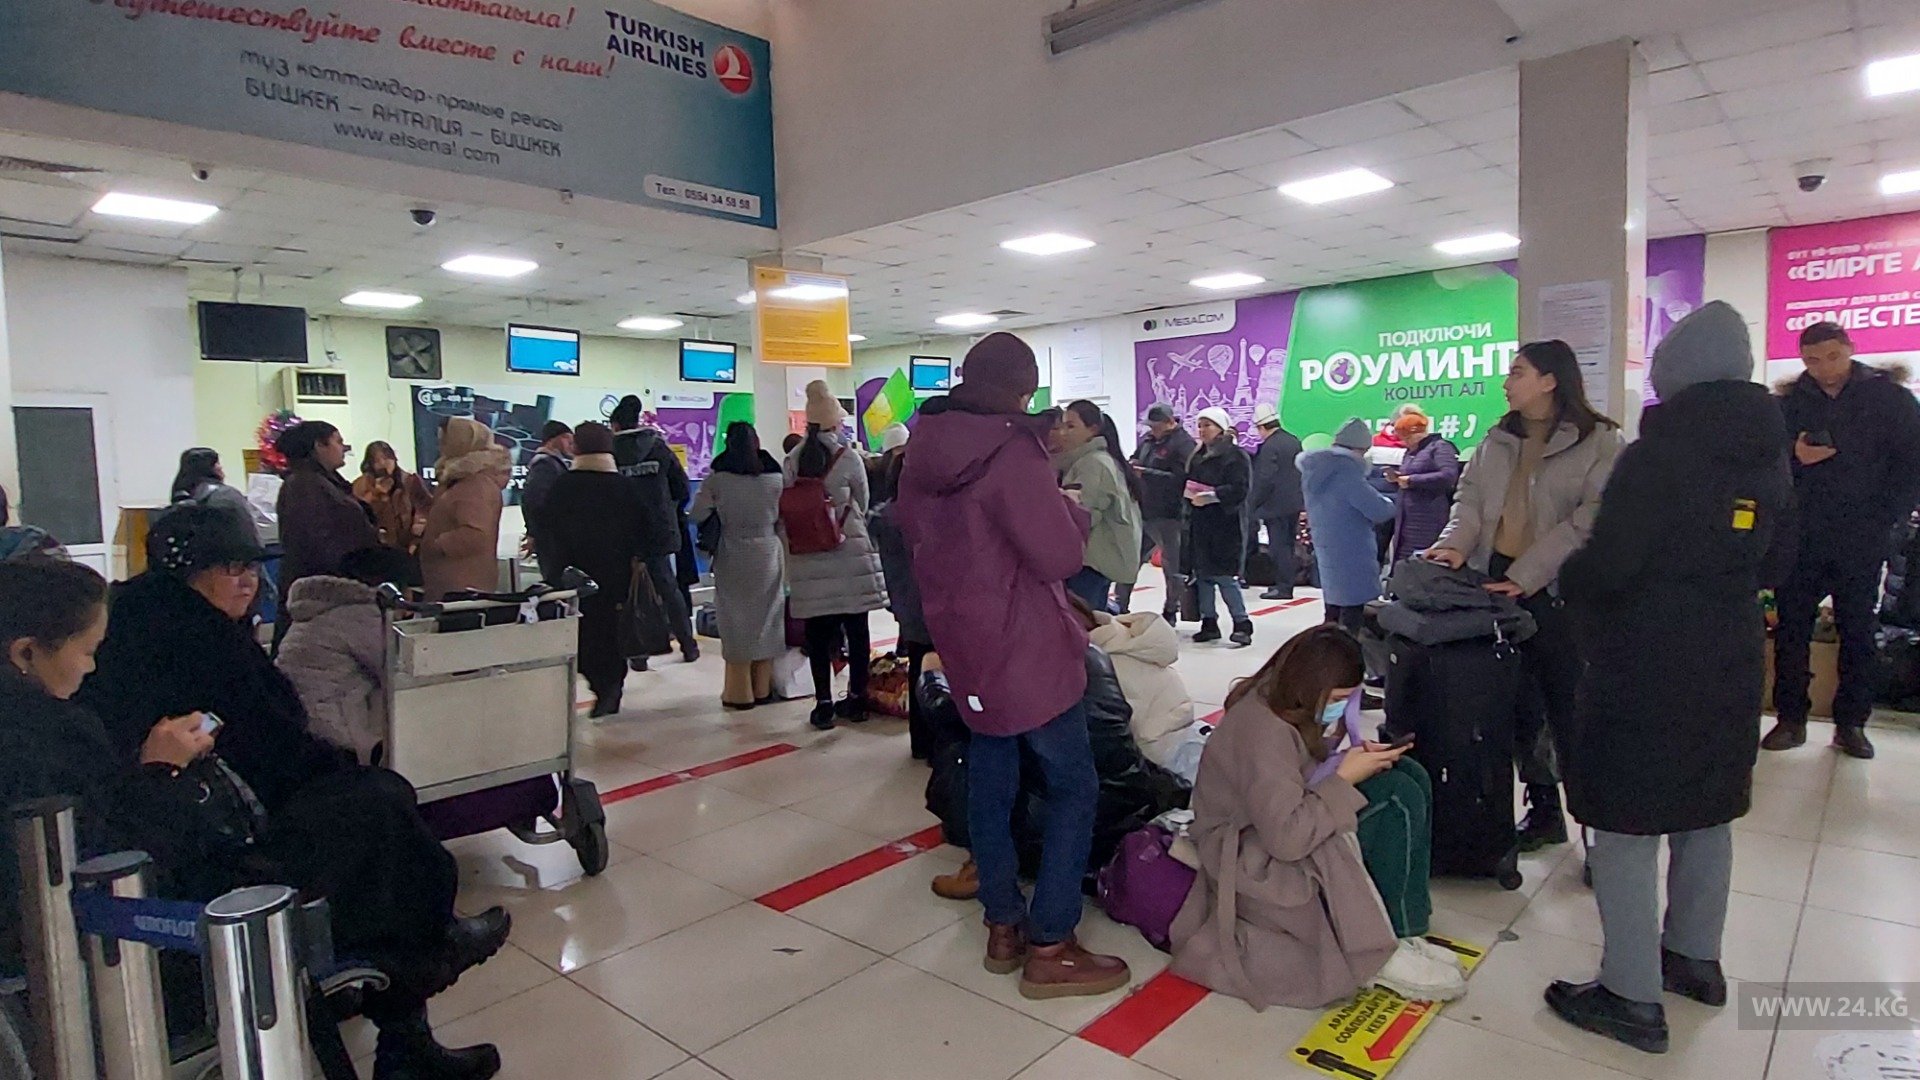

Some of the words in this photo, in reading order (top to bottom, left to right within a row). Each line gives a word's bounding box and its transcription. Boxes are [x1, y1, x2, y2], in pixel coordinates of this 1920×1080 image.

[400, 25, 497, 61] вместе
[512, 49, 525, 65] с
[540, 55, 616, 79] нами!
[604, 10, 705, 58] TURKISH
[606, 34, 708, 79] AIRLINES
[245, 77, 340, 113] БИШКЕК
[371, 102, 463, 137] АНТАЛИЯ
[490, 128, 562, 158] БИШКЕК
[1787, 252, 1902, 281] «БИРГЕ
[1378, 322, 1493, 348] ПОДКЛЮЧИ
[1298, 340, 1520, 392] РОУМИНГ
[1384, 383, 1453, 401] КОШУП
[1458, 381, 1485, 397] АЛ
